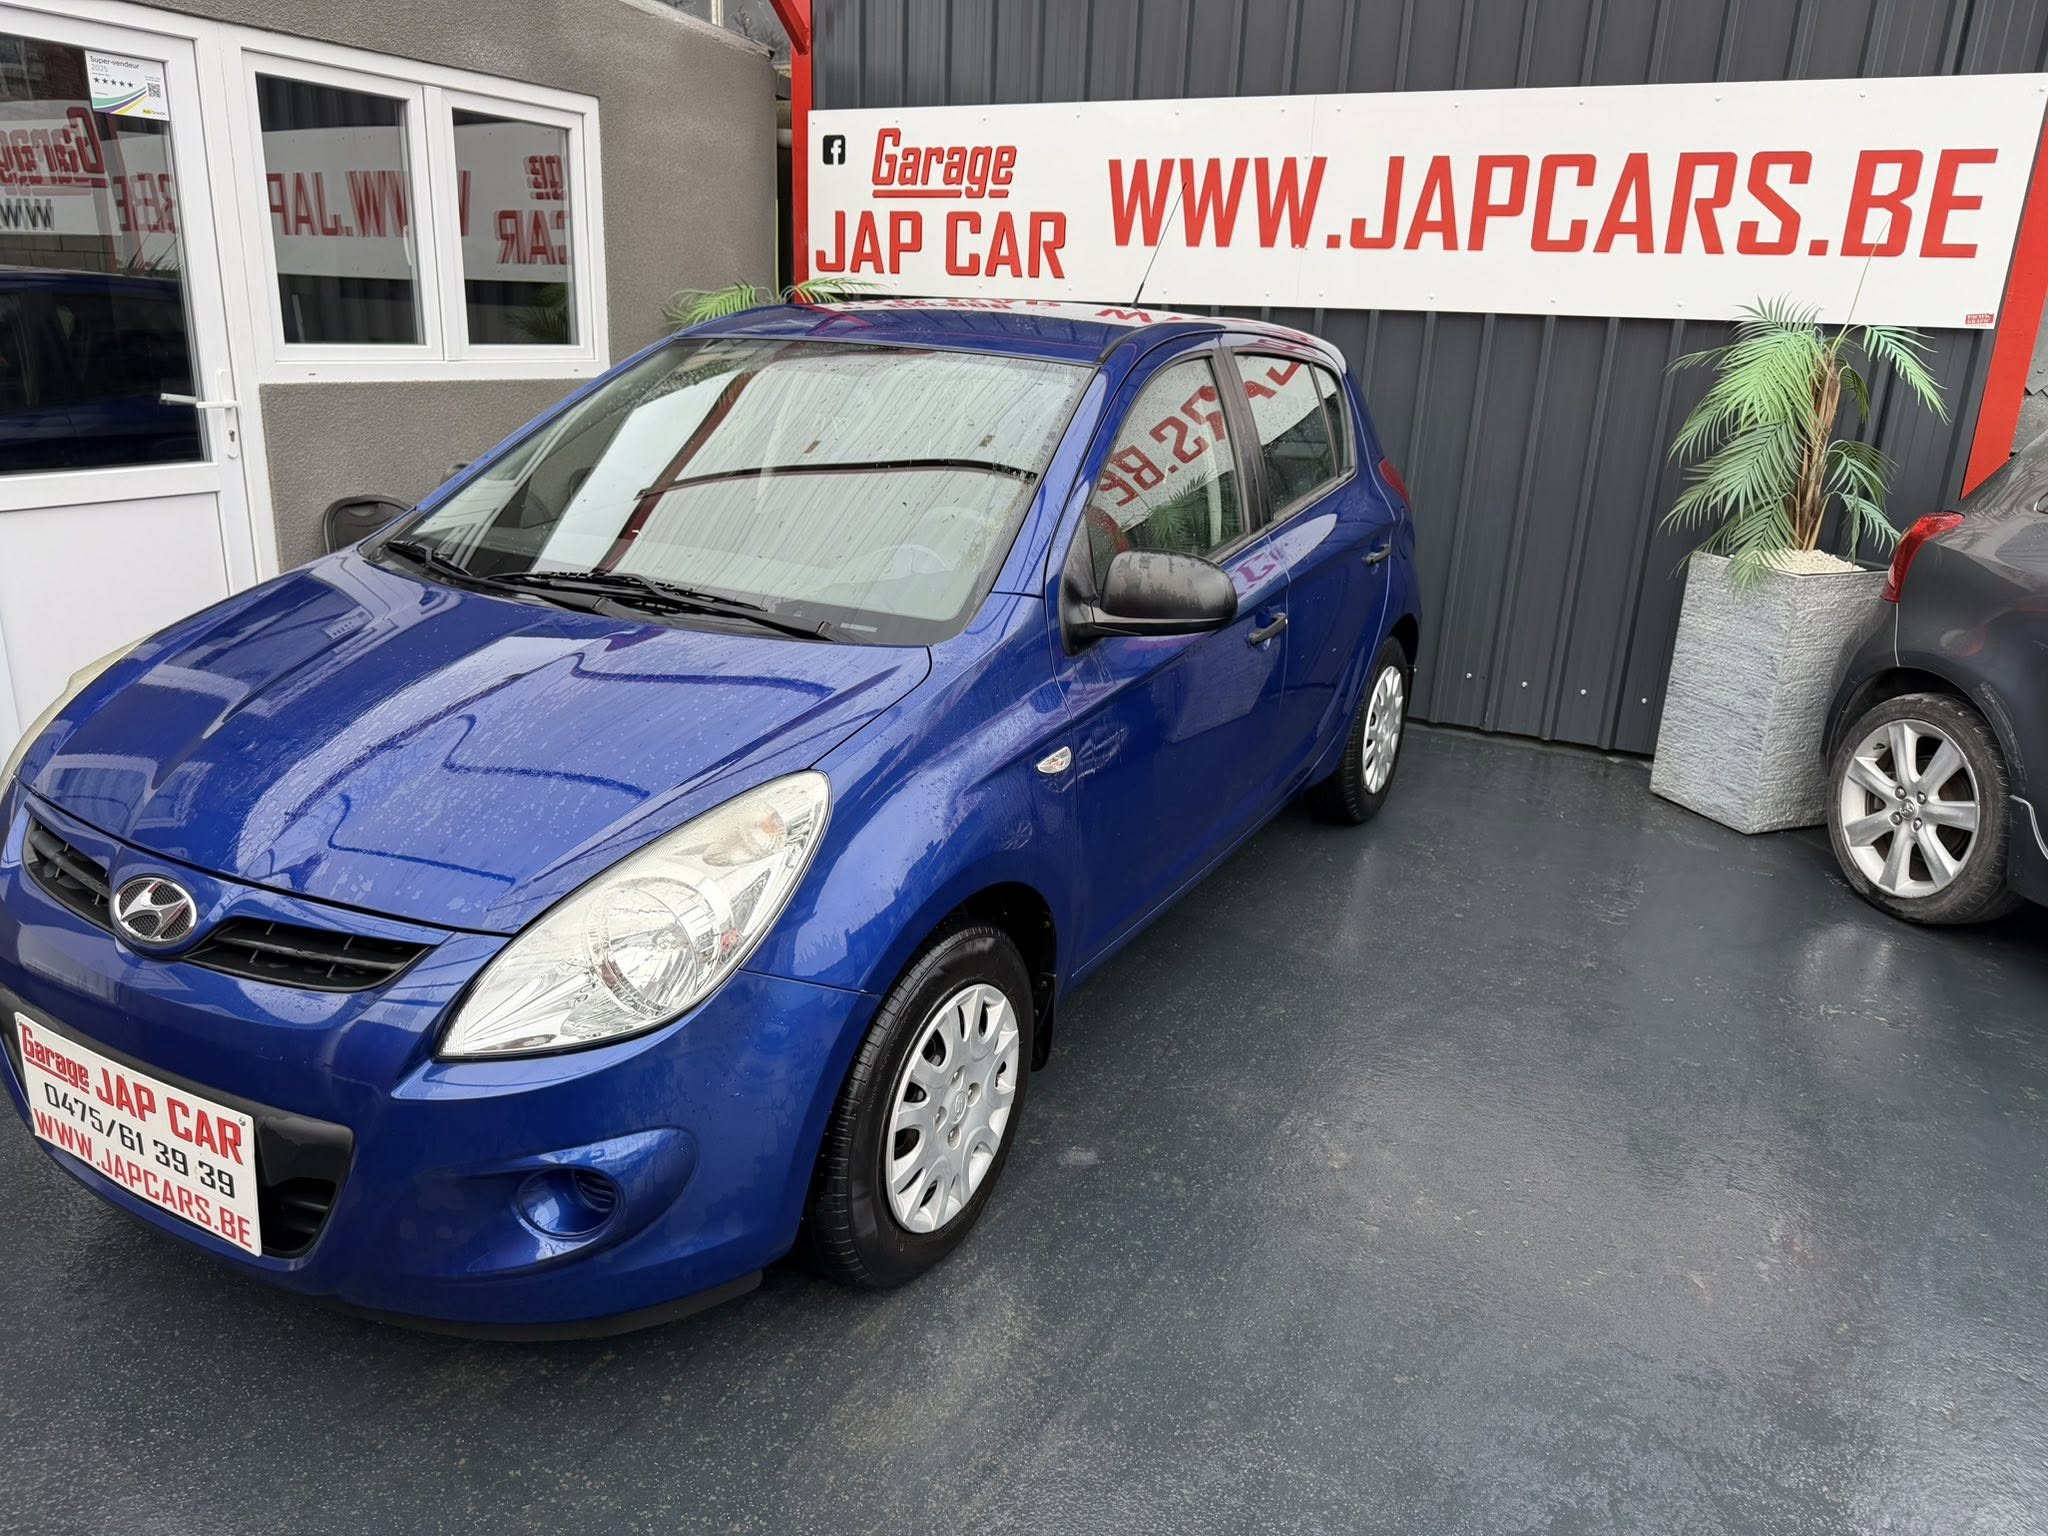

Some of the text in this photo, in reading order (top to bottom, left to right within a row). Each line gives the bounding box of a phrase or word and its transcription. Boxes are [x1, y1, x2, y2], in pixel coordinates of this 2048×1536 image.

[89, 55, 140, 70] Super-vendeur
[872, 127, 1017, 198] Garage
[1109, 148, 1999, 259] WWW.JAPCARS.BE
[815, 210, 1067, 279] JAP CAR
[21, 1023, 245, 1166] Garage JAP CAR
[44, 1081, 236, 1200] 0475/61 39 39
[34, 1107, 253, 1249] WWW.JAPCARS.BE
